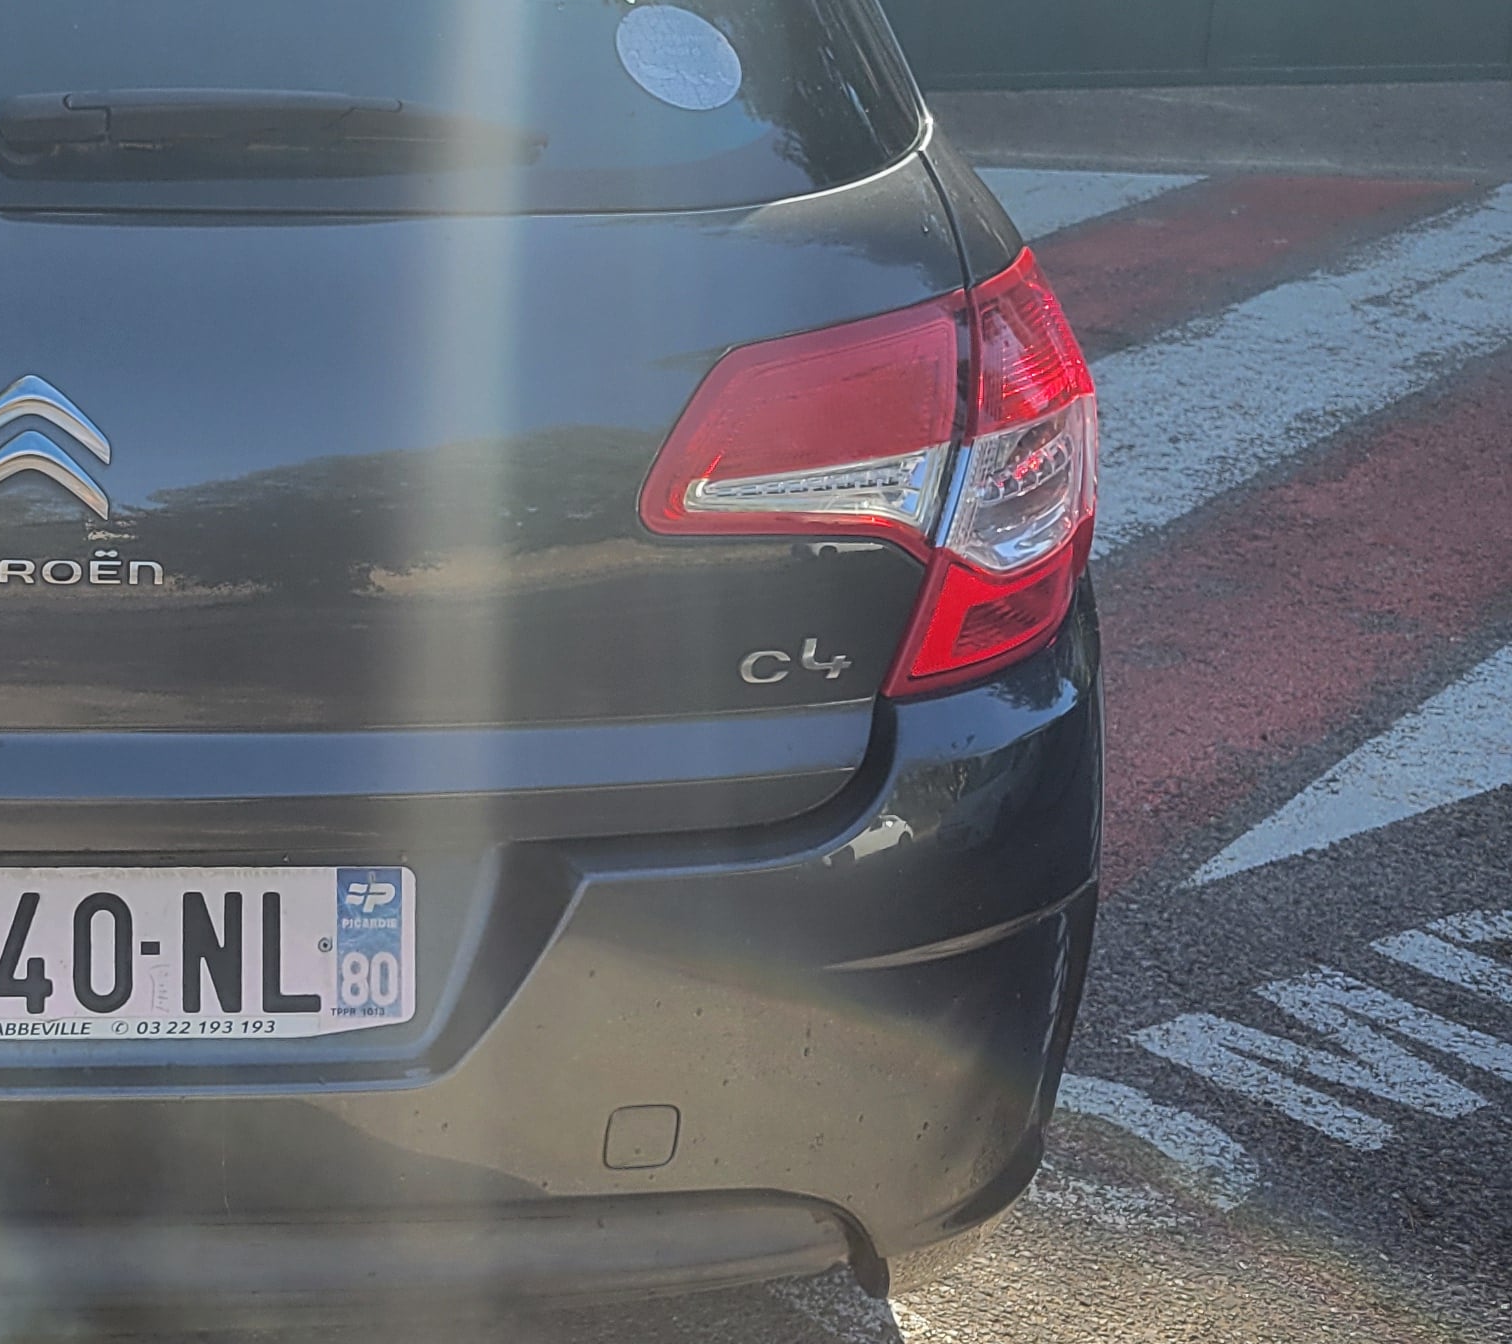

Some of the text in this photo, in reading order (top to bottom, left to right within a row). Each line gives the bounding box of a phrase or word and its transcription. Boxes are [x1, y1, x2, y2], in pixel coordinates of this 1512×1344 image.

[740, 637, 852, 684] C4
[341, 918, 398, 929] PICARDIE
[341, 951, 399, 1007] 80
[136, 1022, 162, 1035] 03
[165, 1022, 191, 1035] 22
[198, 1021, 233, 1034] 193
[240, 1020, 276, 1034] 193
